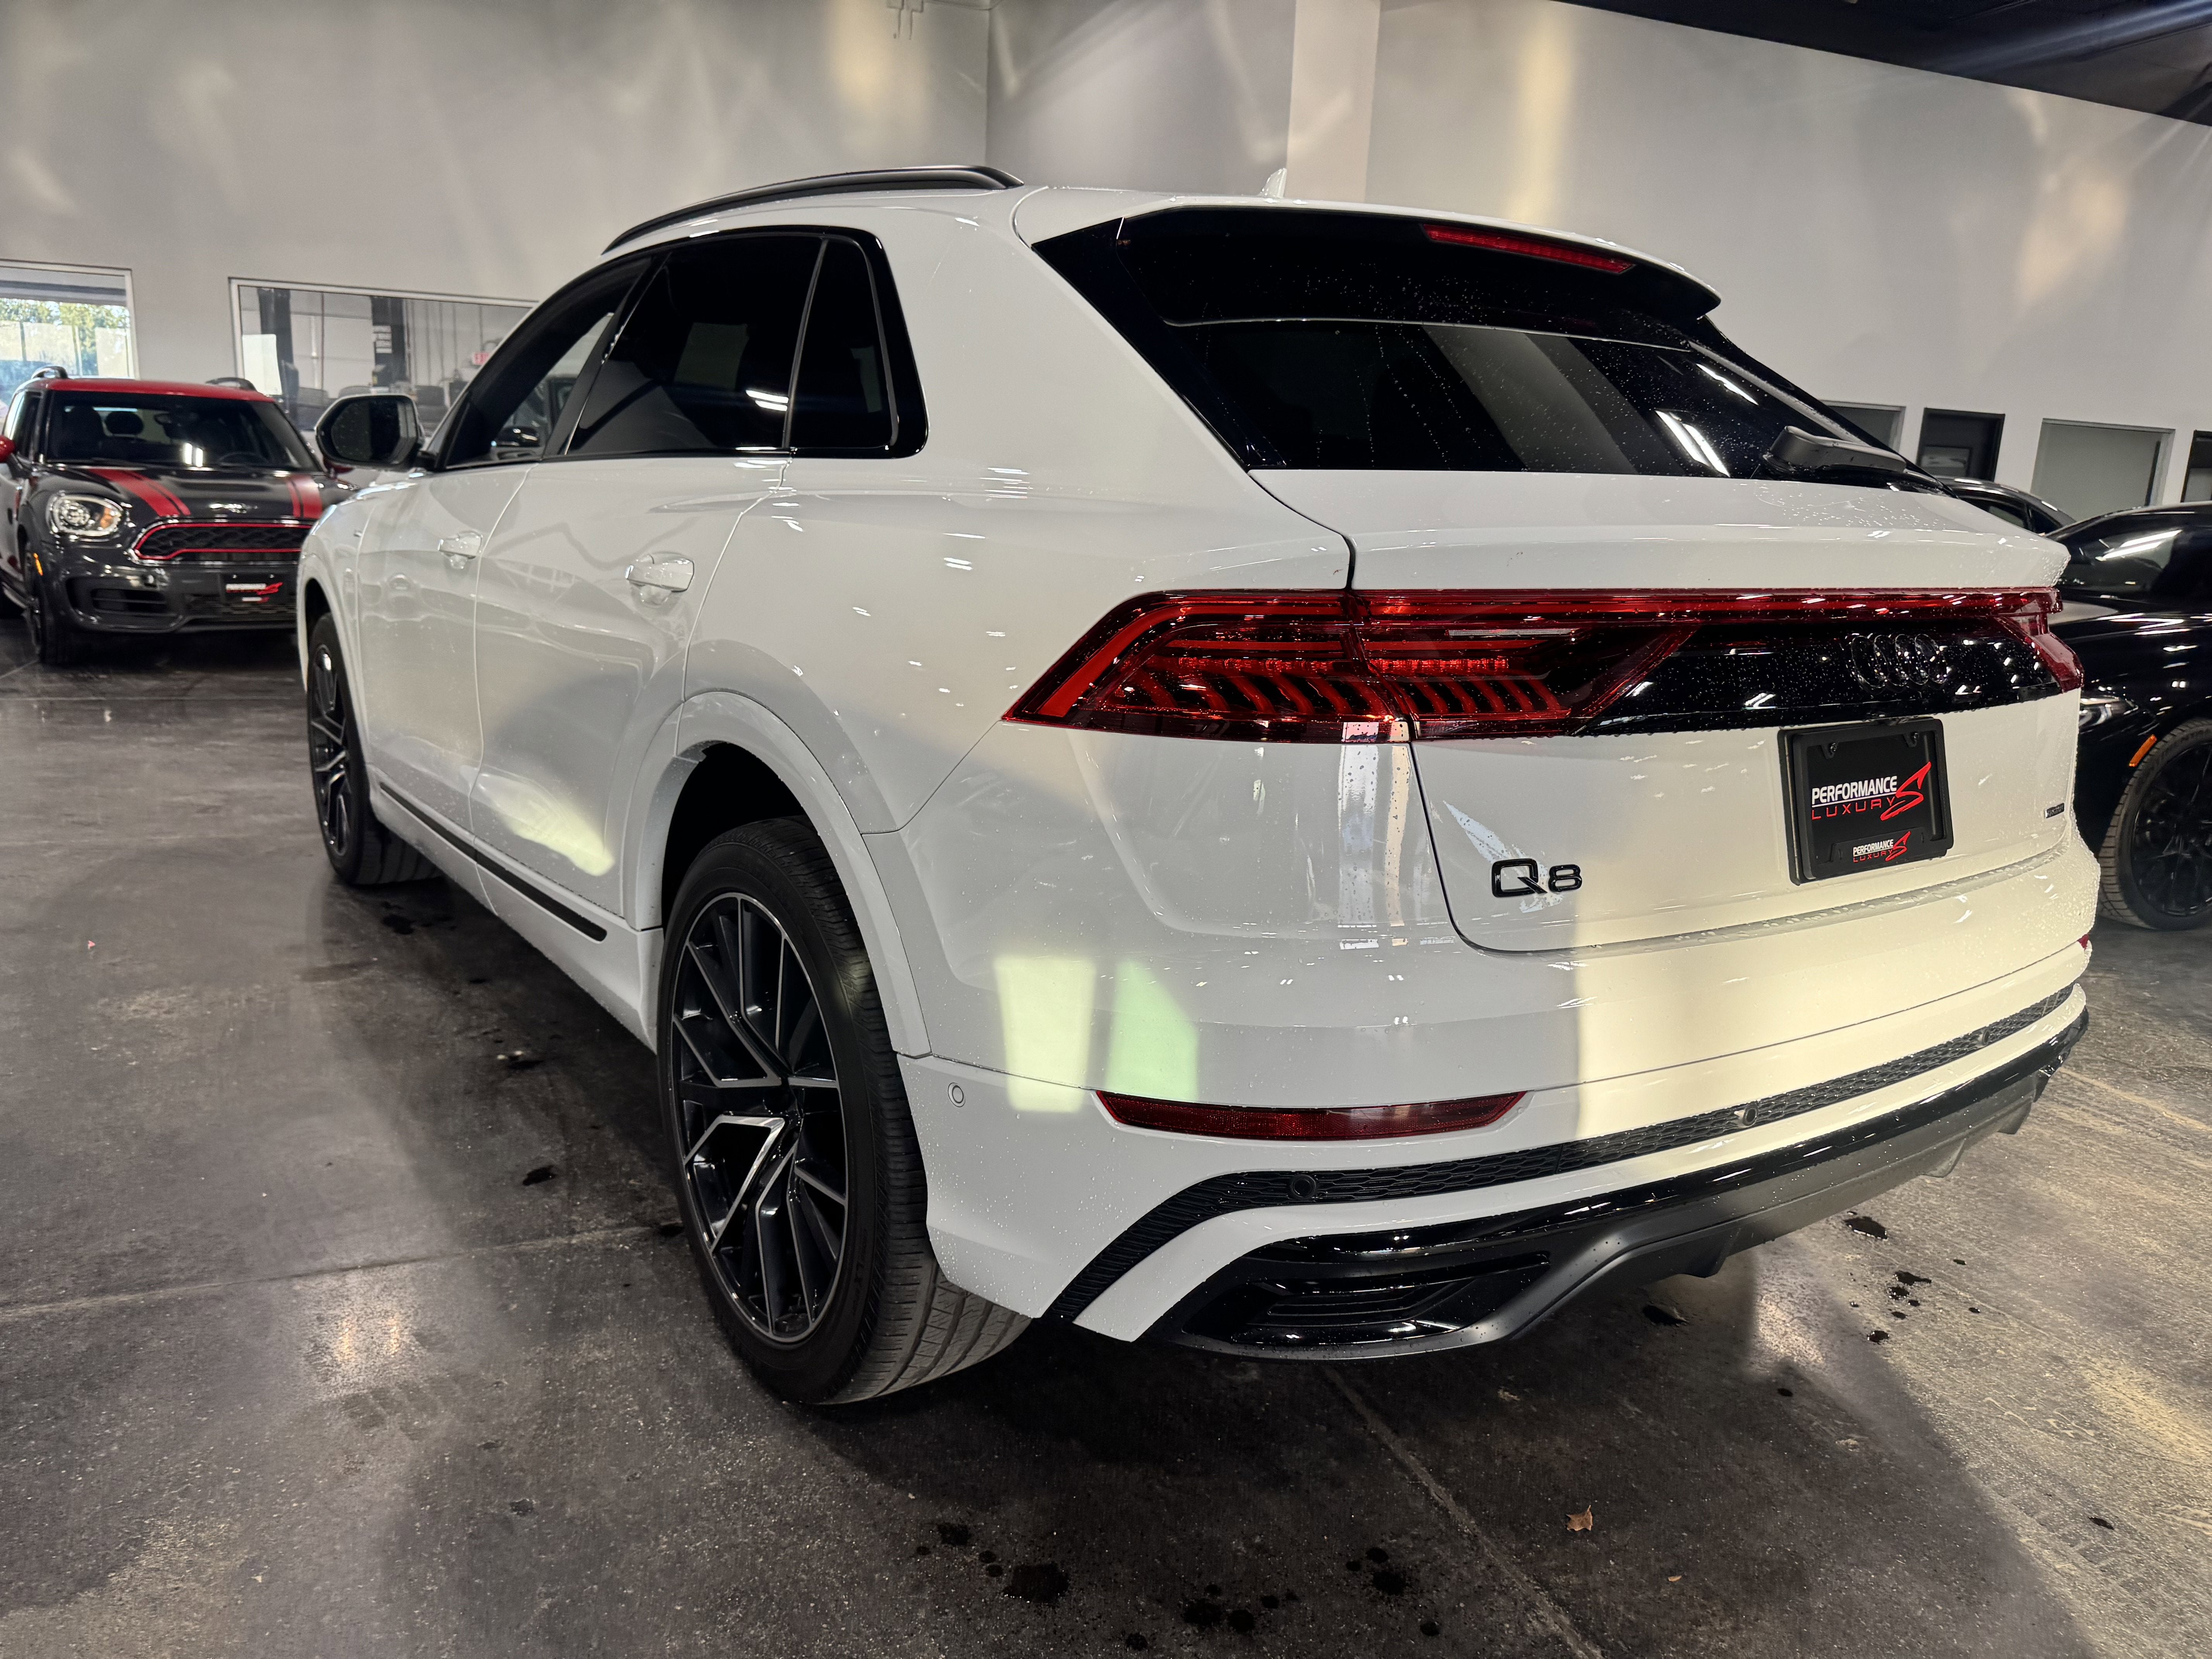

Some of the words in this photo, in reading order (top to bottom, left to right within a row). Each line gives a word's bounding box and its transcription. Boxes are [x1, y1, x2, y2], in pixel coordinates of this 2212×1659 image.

[1812, 775, 1898, 805] PERFORMANCE
[1812, 796, 1895, 820] LUXURY
[1853, 839, 1894, 855] PERFORMANCE
[1853, 849, 1893, 863] LUXURY
[1491, 858, 1582, 898] Q8
